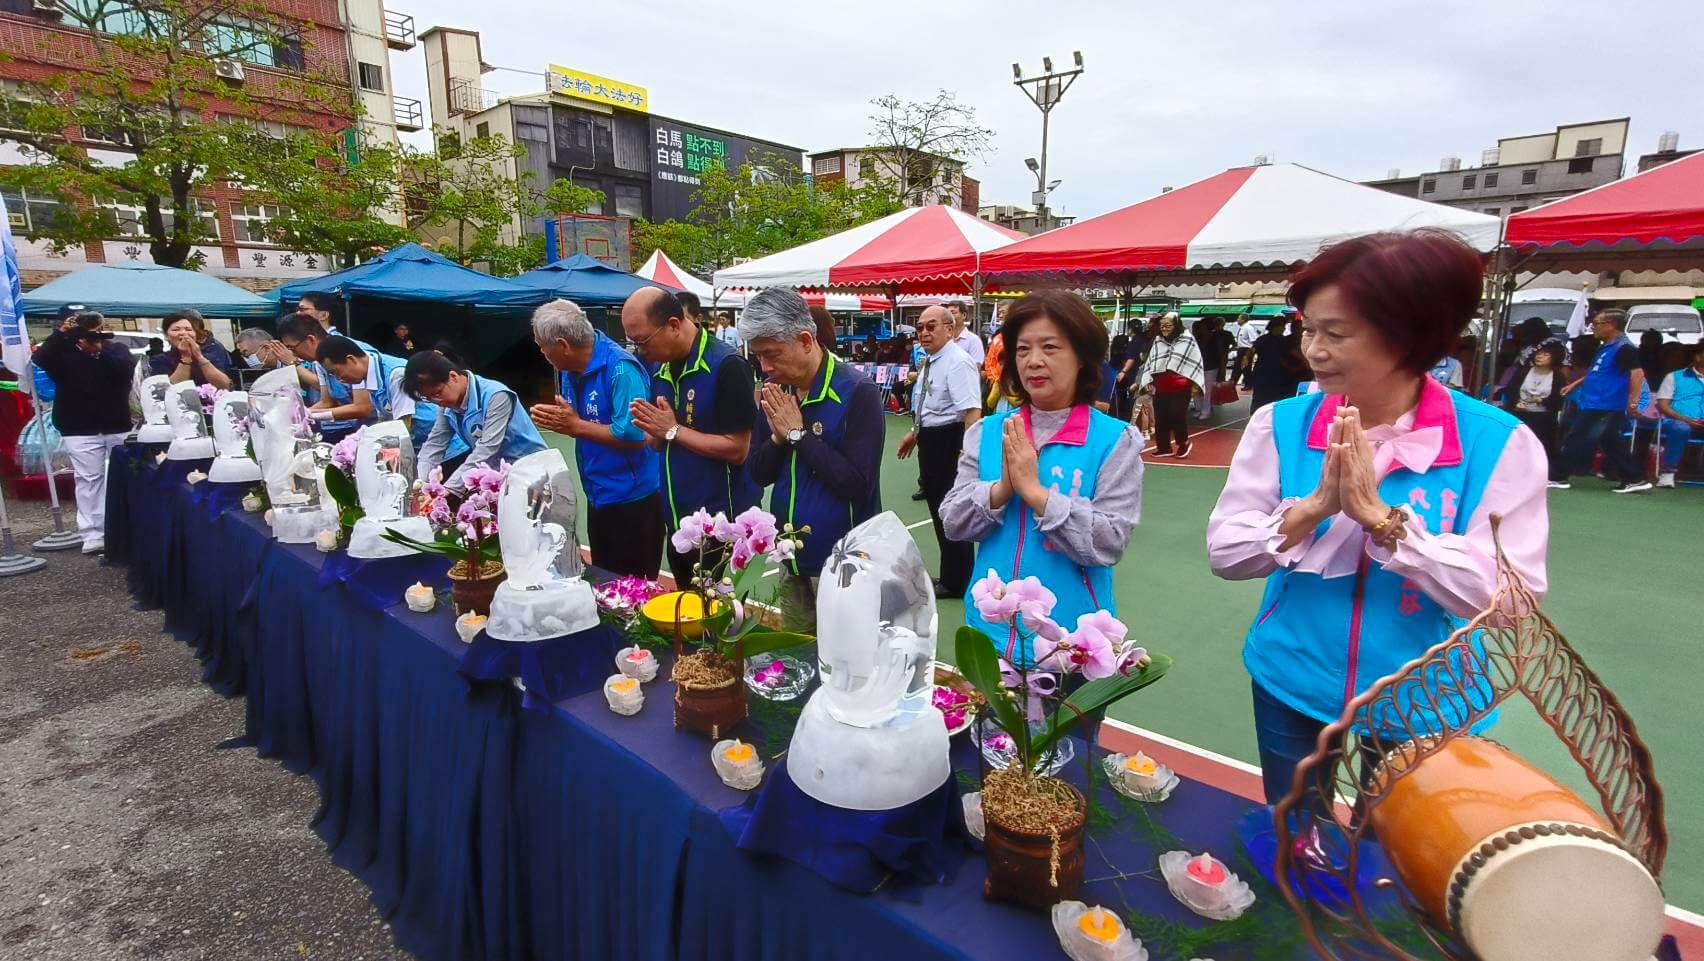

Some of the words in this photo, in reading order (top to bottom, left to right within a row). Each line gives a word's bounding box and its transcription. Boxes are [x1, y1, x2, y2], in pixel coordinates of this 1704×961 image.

[656, 127, 683, 149] 白馬
[686, 133, 725, 157] 點不到
[657, 147, 684, 169] 白鴿
